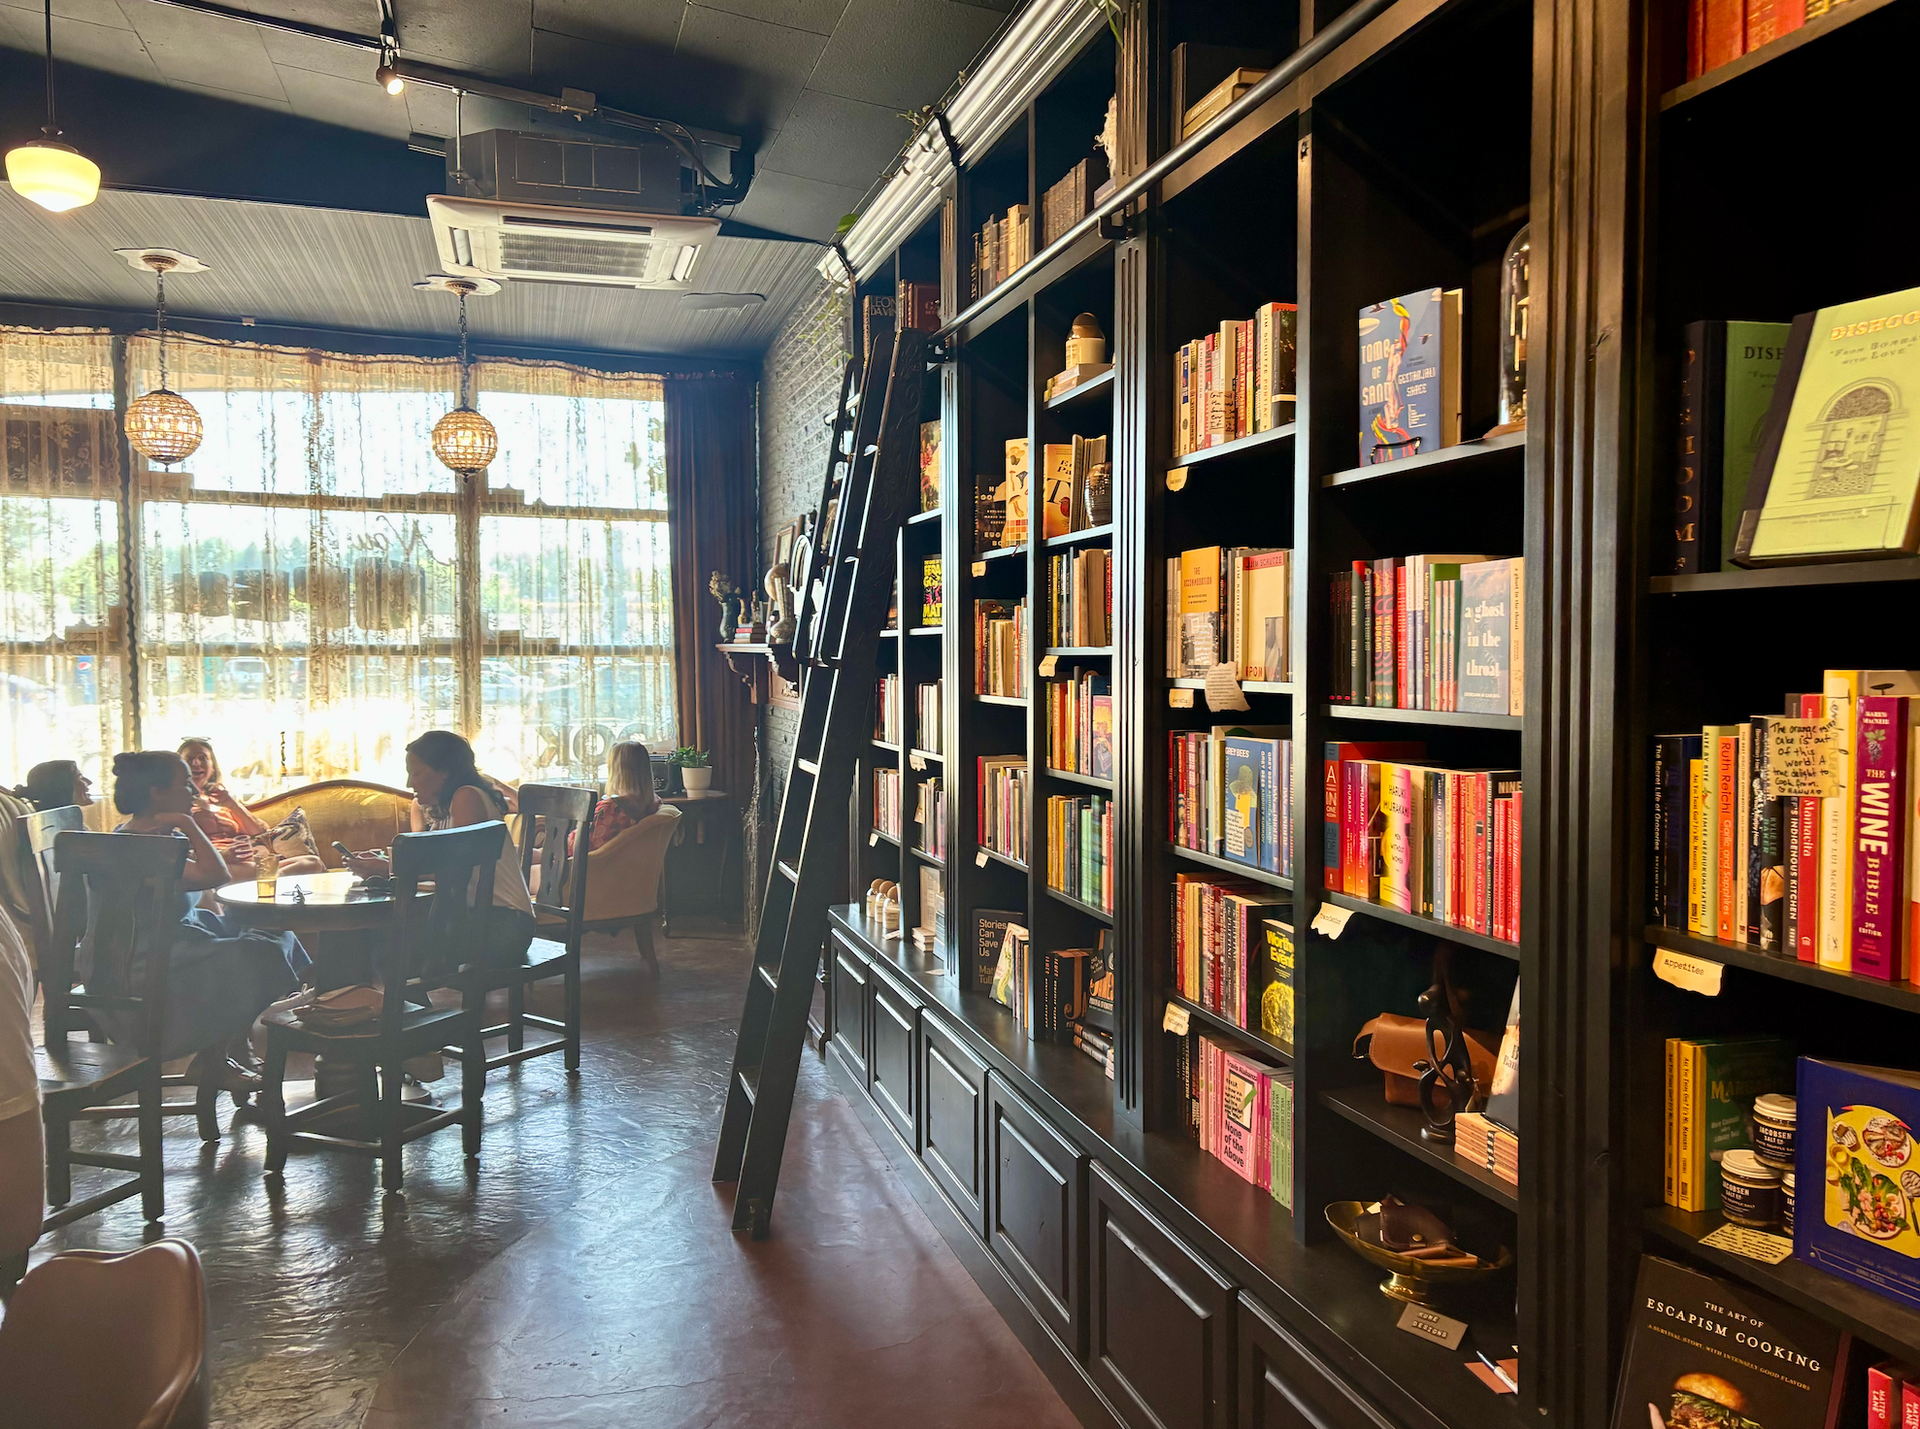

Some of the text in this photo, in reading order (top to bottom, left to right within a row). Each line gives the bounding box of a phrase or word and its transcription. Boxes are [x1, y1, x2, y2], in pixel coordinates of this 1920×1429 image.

[1465, 600, 1505, 623] a ghost
[1467, 630, 1500, 647] in the
[1770, 722, 1785, 733] The
[1794, 746, 1815, 756] this
[1326, 765, 1335, 783] A
[1721, 742, 1731, 814] Ruth Reichl
[1866, 769, 1886, 779] THE
[1654, 803, 1662, 811] of
[1802, 799, 1815, 857] Mamacita
[1830, 810, 1839, 844] HETTY
[1790, 818, 1798, 877] INDIGENOUS
[1860, 782, 1890, 916] WINE BIBLE
[1830, 848, 1839, 866] LUI
[1722, 820, 1731, 915] Garlic and Sapphires
[1790, 880, 1798, 920] KITCHEN
[979, 919, 1007, 929] Stories
[979, 929, 995, 938] Can
[979, 938, 999, 948] Save
[979, 947, 990, 957] Us
[1664, 957, 1705, 976] appetites
[1225, 1120, 1242, 1138] None
[1759, 1126, 1792, 1139] JACOBSEN
[1224, 1134, 1244, 1154] of the
[1224, 1146, 1244, 1168] Above
[1704, 1301, 1764, 1328] THE ART OF
[1412, 1321, 1448, 1338] DESIGNS
[1646, 1297, 1822, 1373] ESCAPISM COOKING
[1706, 1346, 1722, 1356] WITH
[1760, 1367, 1779, 1379] GOOD
[1780, 1374, 1810, 1391] FLAVORS
